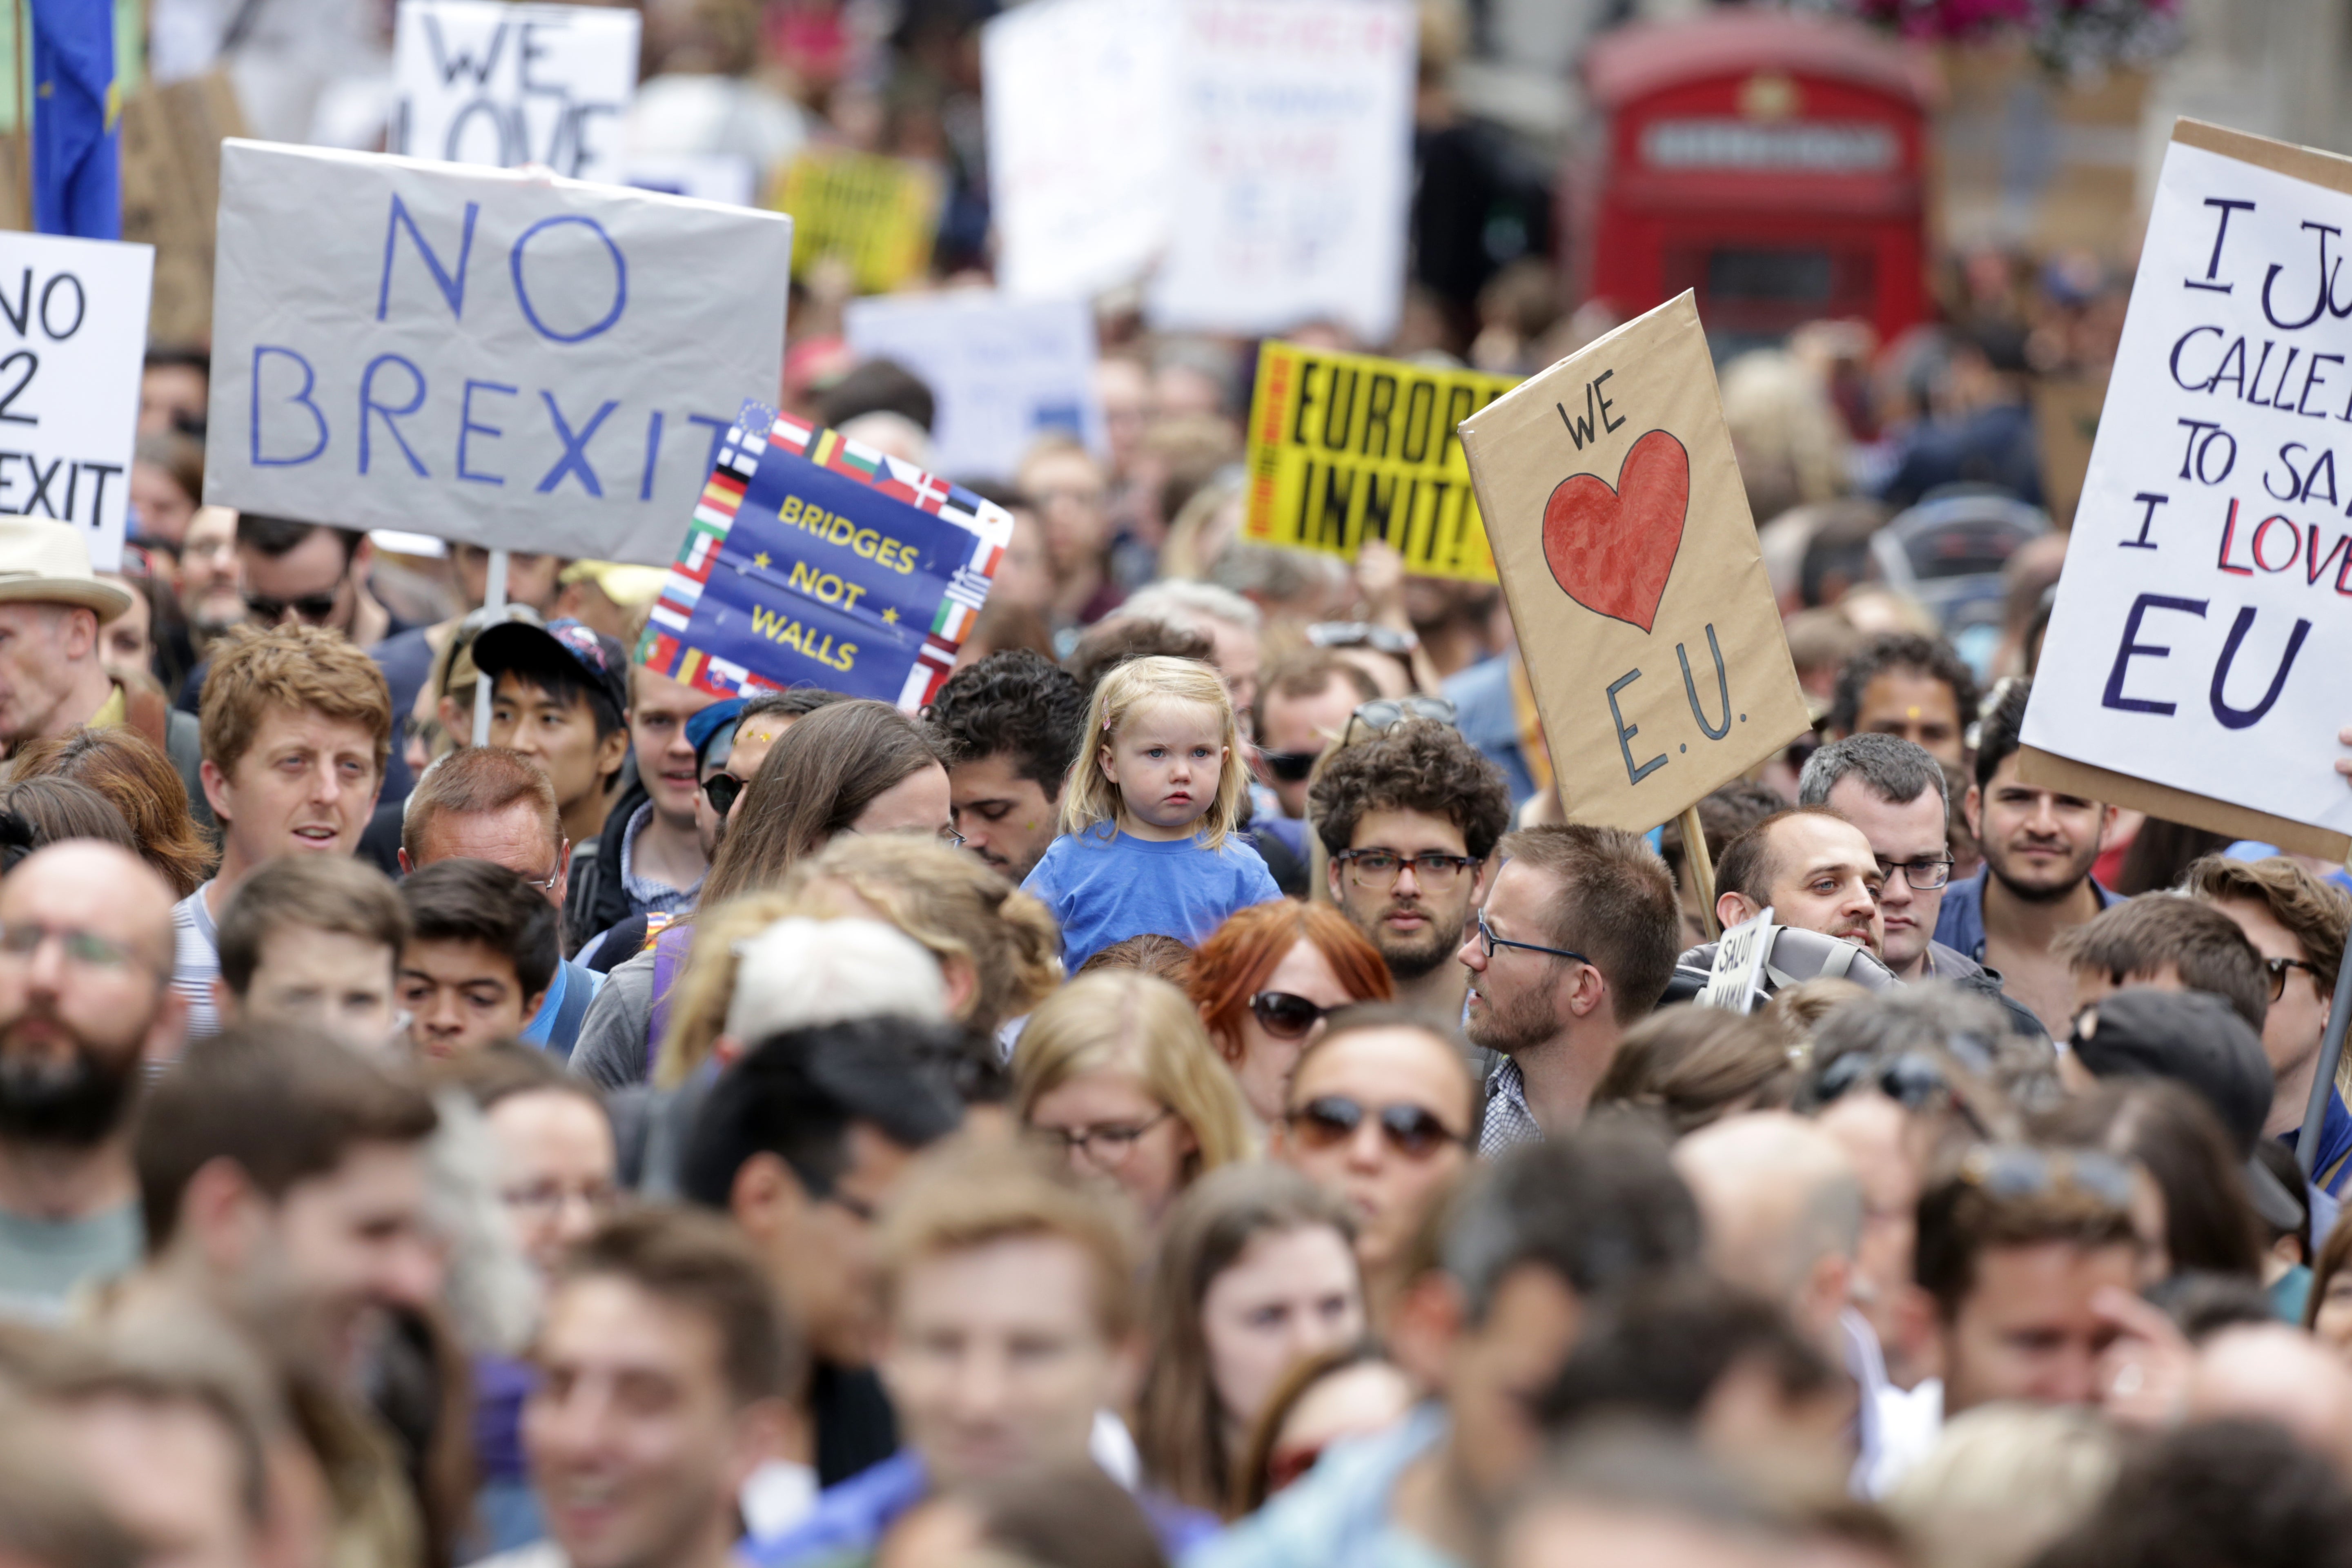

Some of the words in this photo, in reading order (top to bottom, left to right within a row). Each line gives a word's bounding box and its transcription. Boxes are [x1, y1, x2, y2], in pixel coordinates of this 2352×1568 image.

[420, 13, 572, 96] WE
[376, 191, 627, 344] NO
[2184, 198, 2256, 294] I
[0, 349, 39, 424] 2
[1557, 369, 1626, 451] WE
[2169, 326, 2352, 421] CALLE
[251, 345, 737, 501] BREXIT
[2178, 417, 2237, 486] TO
[2263, 442, 2352, 516] SA
[778, 494, 920, 575] BRIDGES
[1298, 460, 1473, 564] INNIT!
[2118, 492, 2169, 550] I
[788, 561, 867, 612] NOT
[751, 604, 859, 673] WALLS
[2101, 591, 2313, 730] EU
[1606, 622, 1747, 786] E.U.
[1719, 928, 1757, 975] SALUT
